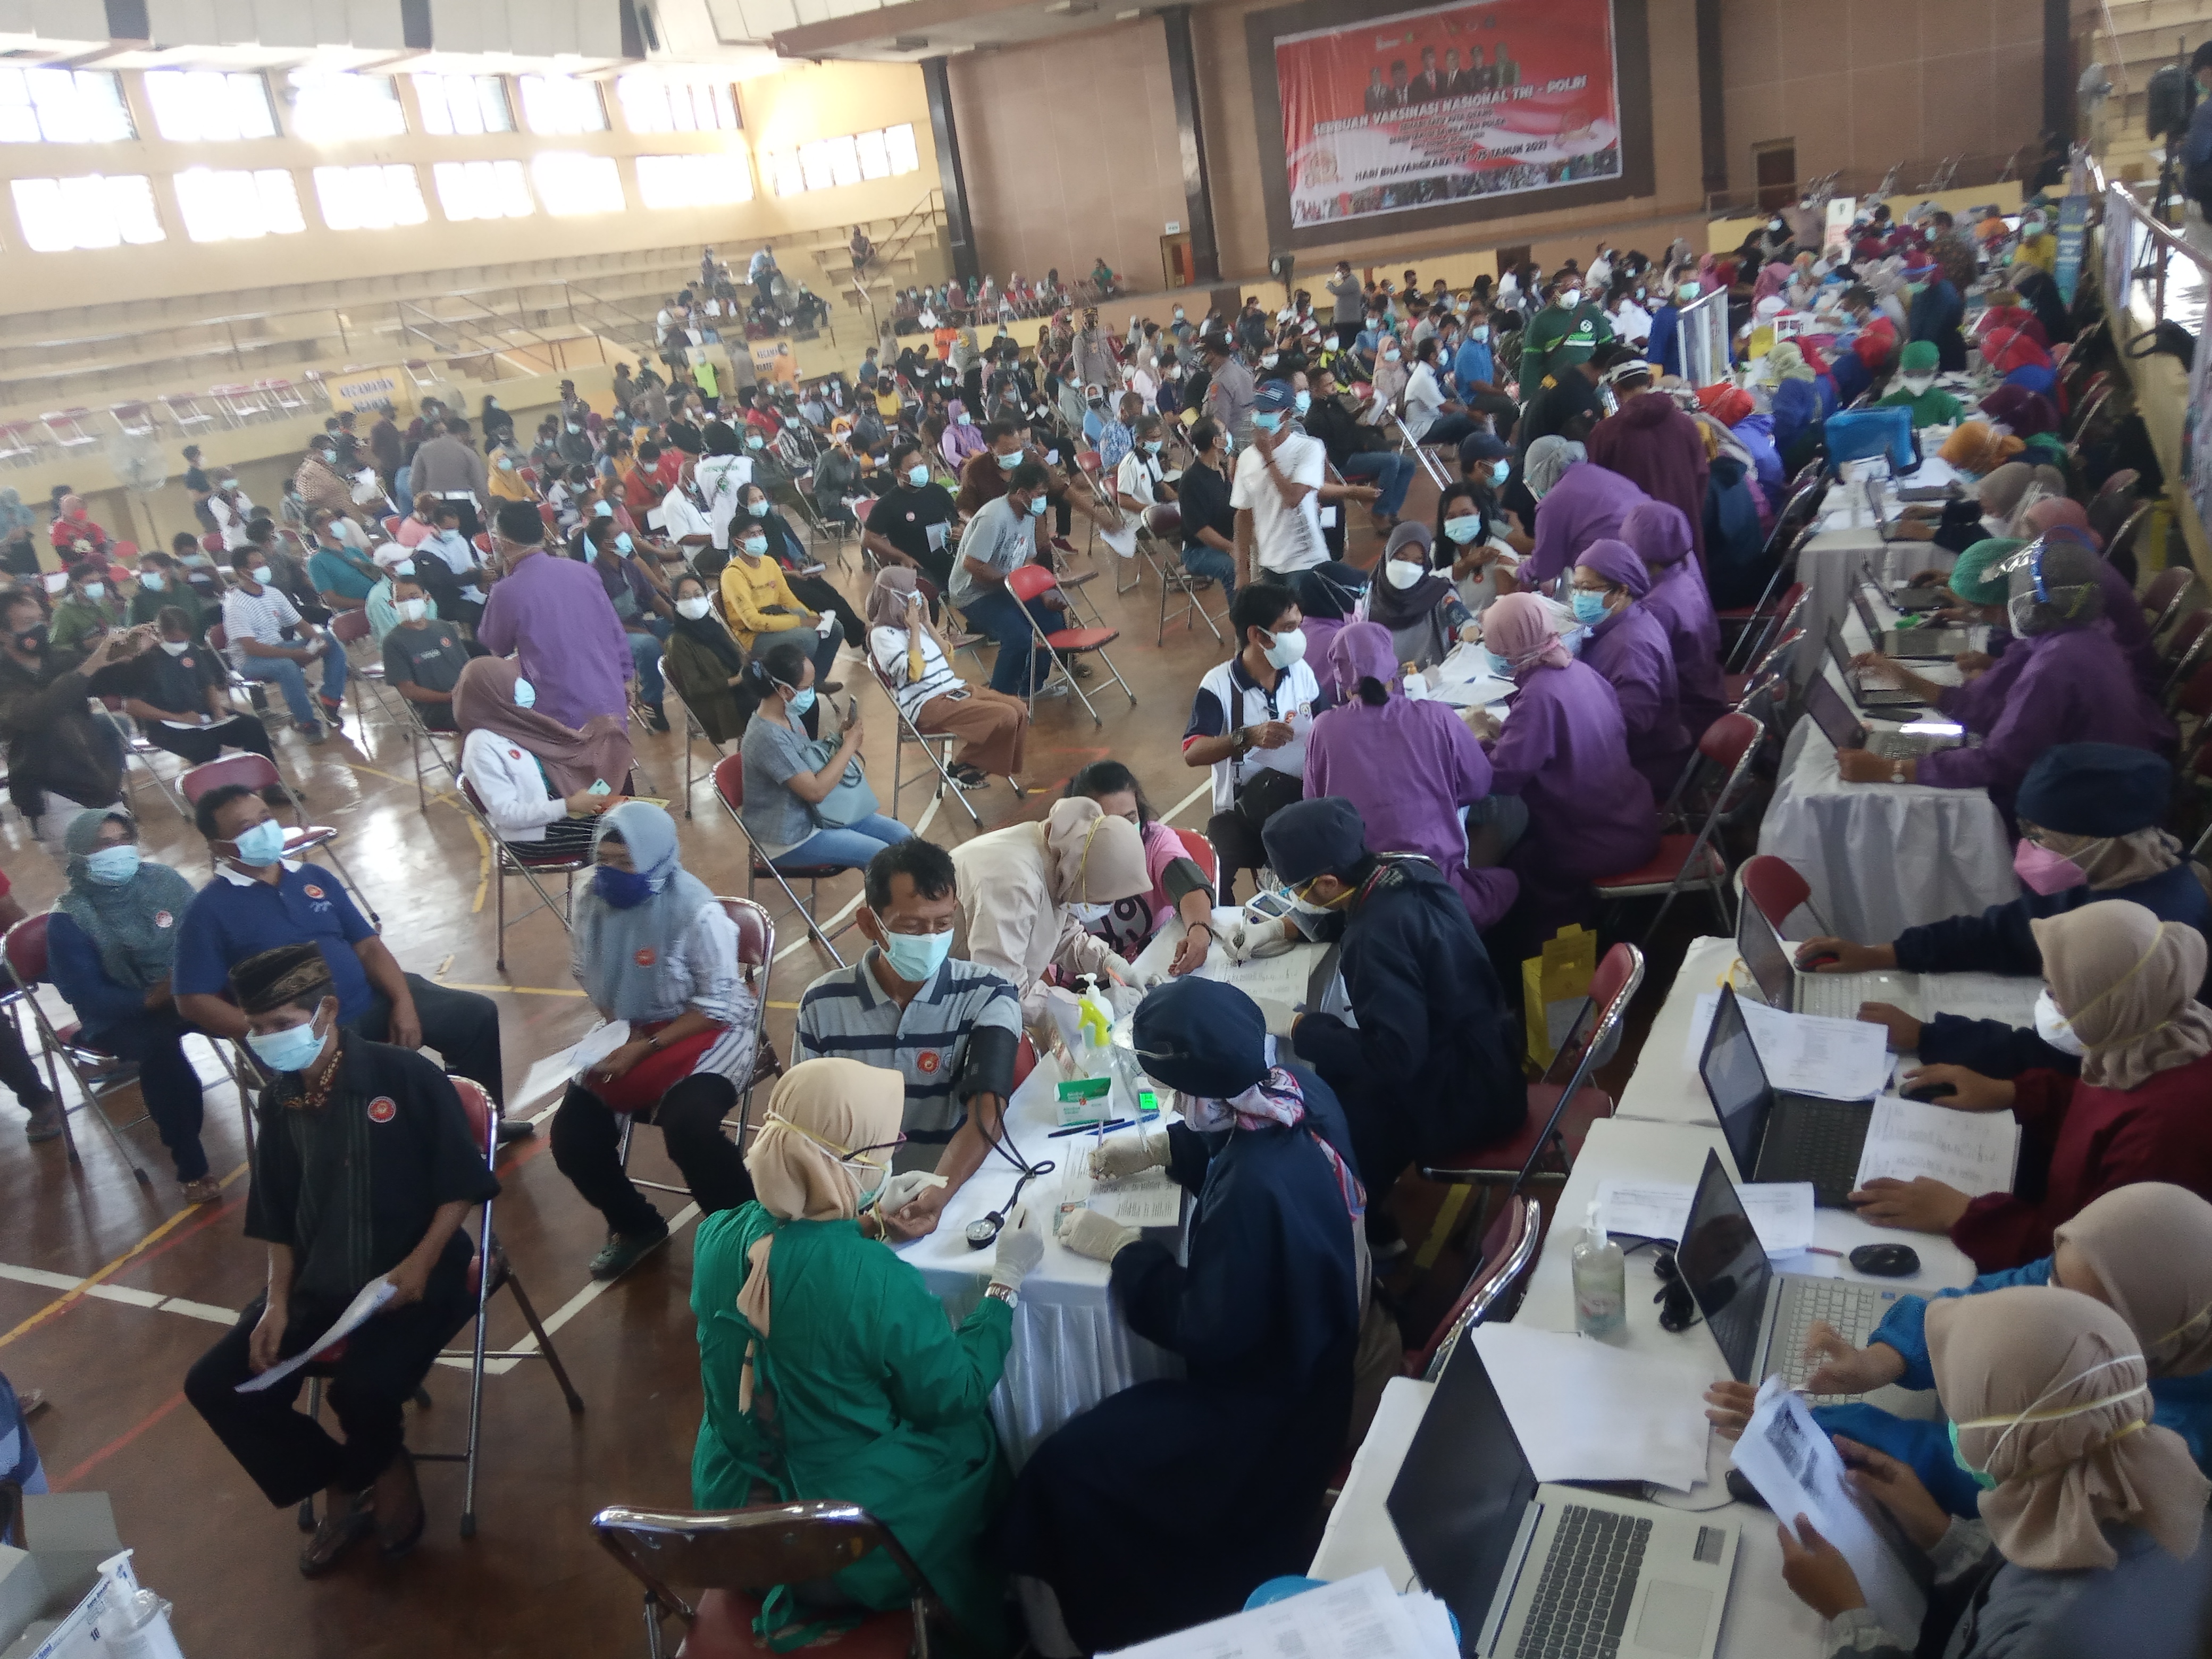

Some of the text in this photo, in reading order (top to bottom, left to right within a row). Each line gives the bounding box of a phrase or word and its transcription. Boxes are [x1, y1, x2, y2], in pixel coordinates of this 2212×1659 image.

[1372, 101, 1439, 125] VAKSINASI
[1442, 89, 1509, 112] NASIONAL
[1512, 85, 1535, 100] TNI
[1547, 74, 1587, 94] POLRI
[1355, 167, 1378, 182] HARI
[1492, 143, 1524, 157] TAHUN
[1526, 140, 1548, 153] 2021
[757, 347, 778, 358] KECAMA
